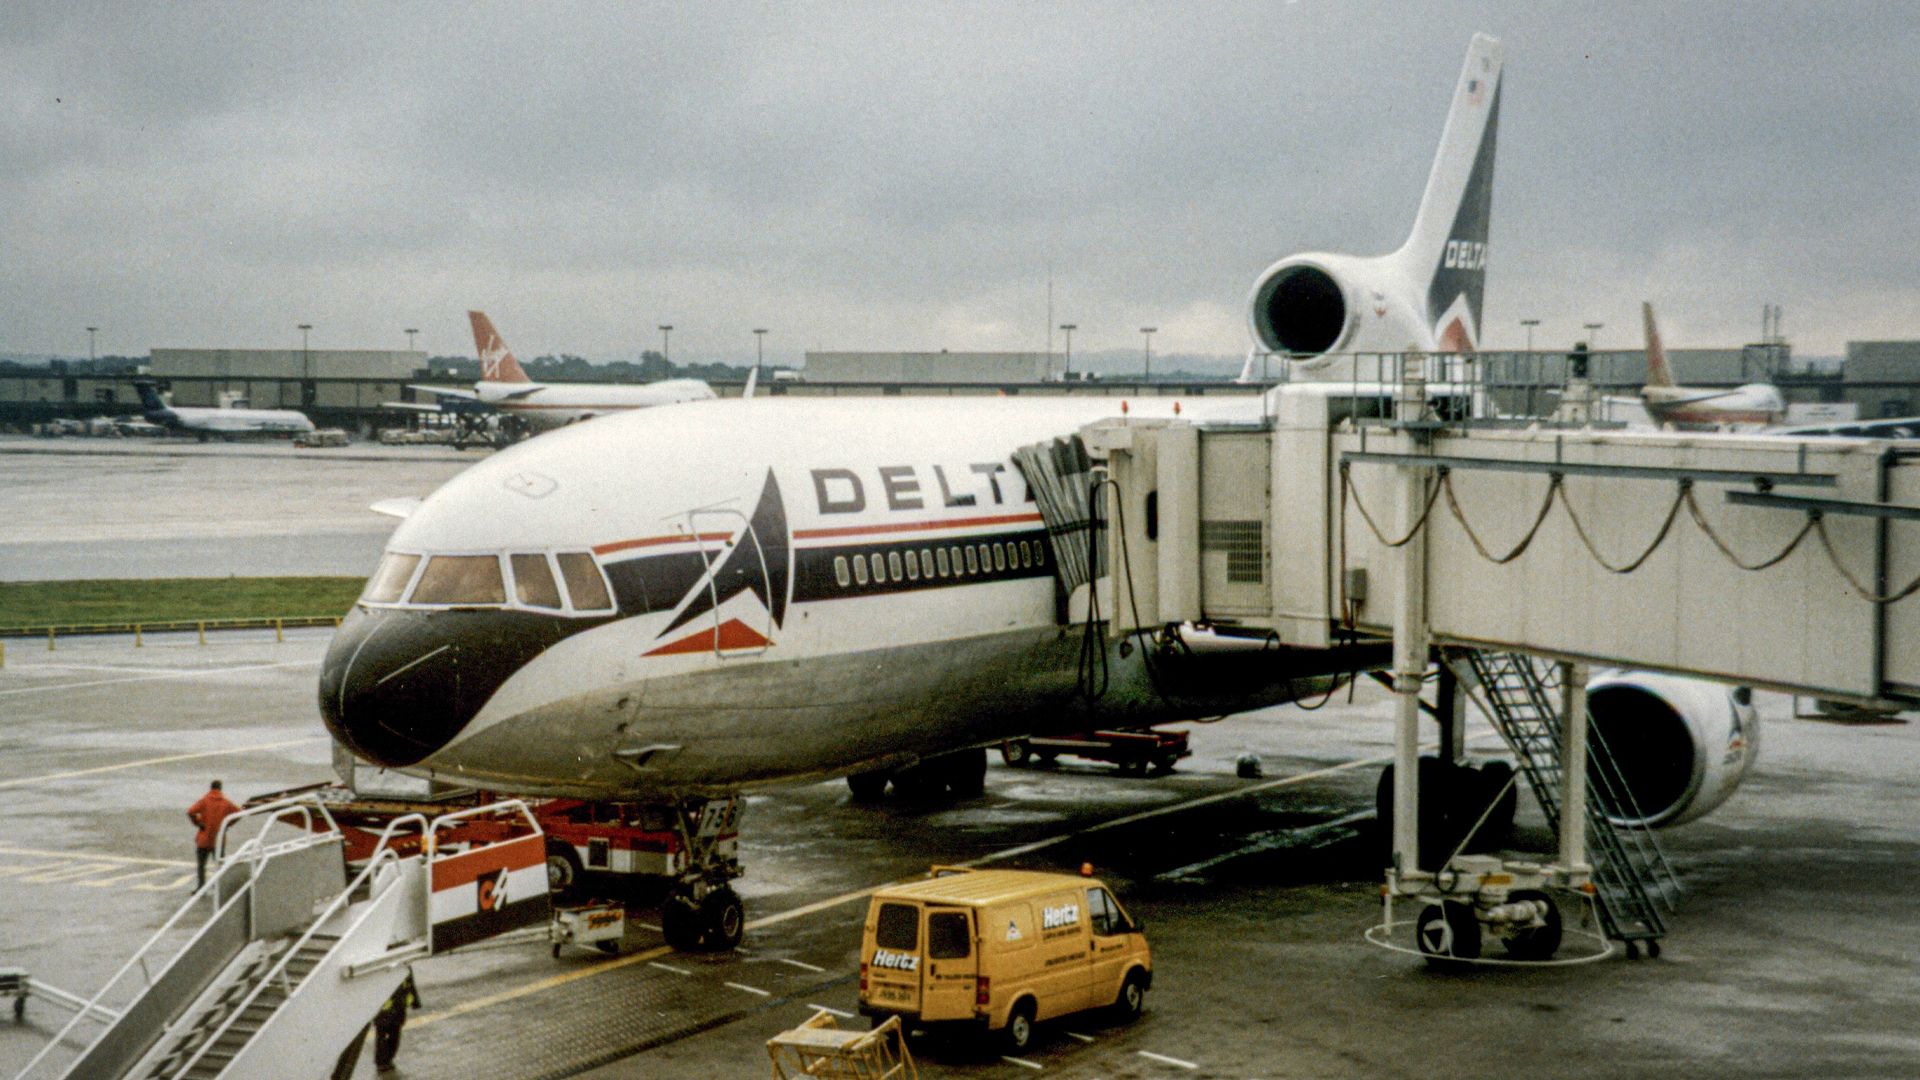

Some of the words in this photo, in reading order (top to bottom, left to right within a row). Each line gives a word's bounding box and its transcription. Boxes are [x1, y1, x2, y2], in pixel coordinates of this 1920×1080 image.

[810, 462, 1037, 515] DELT
[1043, 904, 1078, 928] Hertz
[872, 949, 920, 971] Hertz
